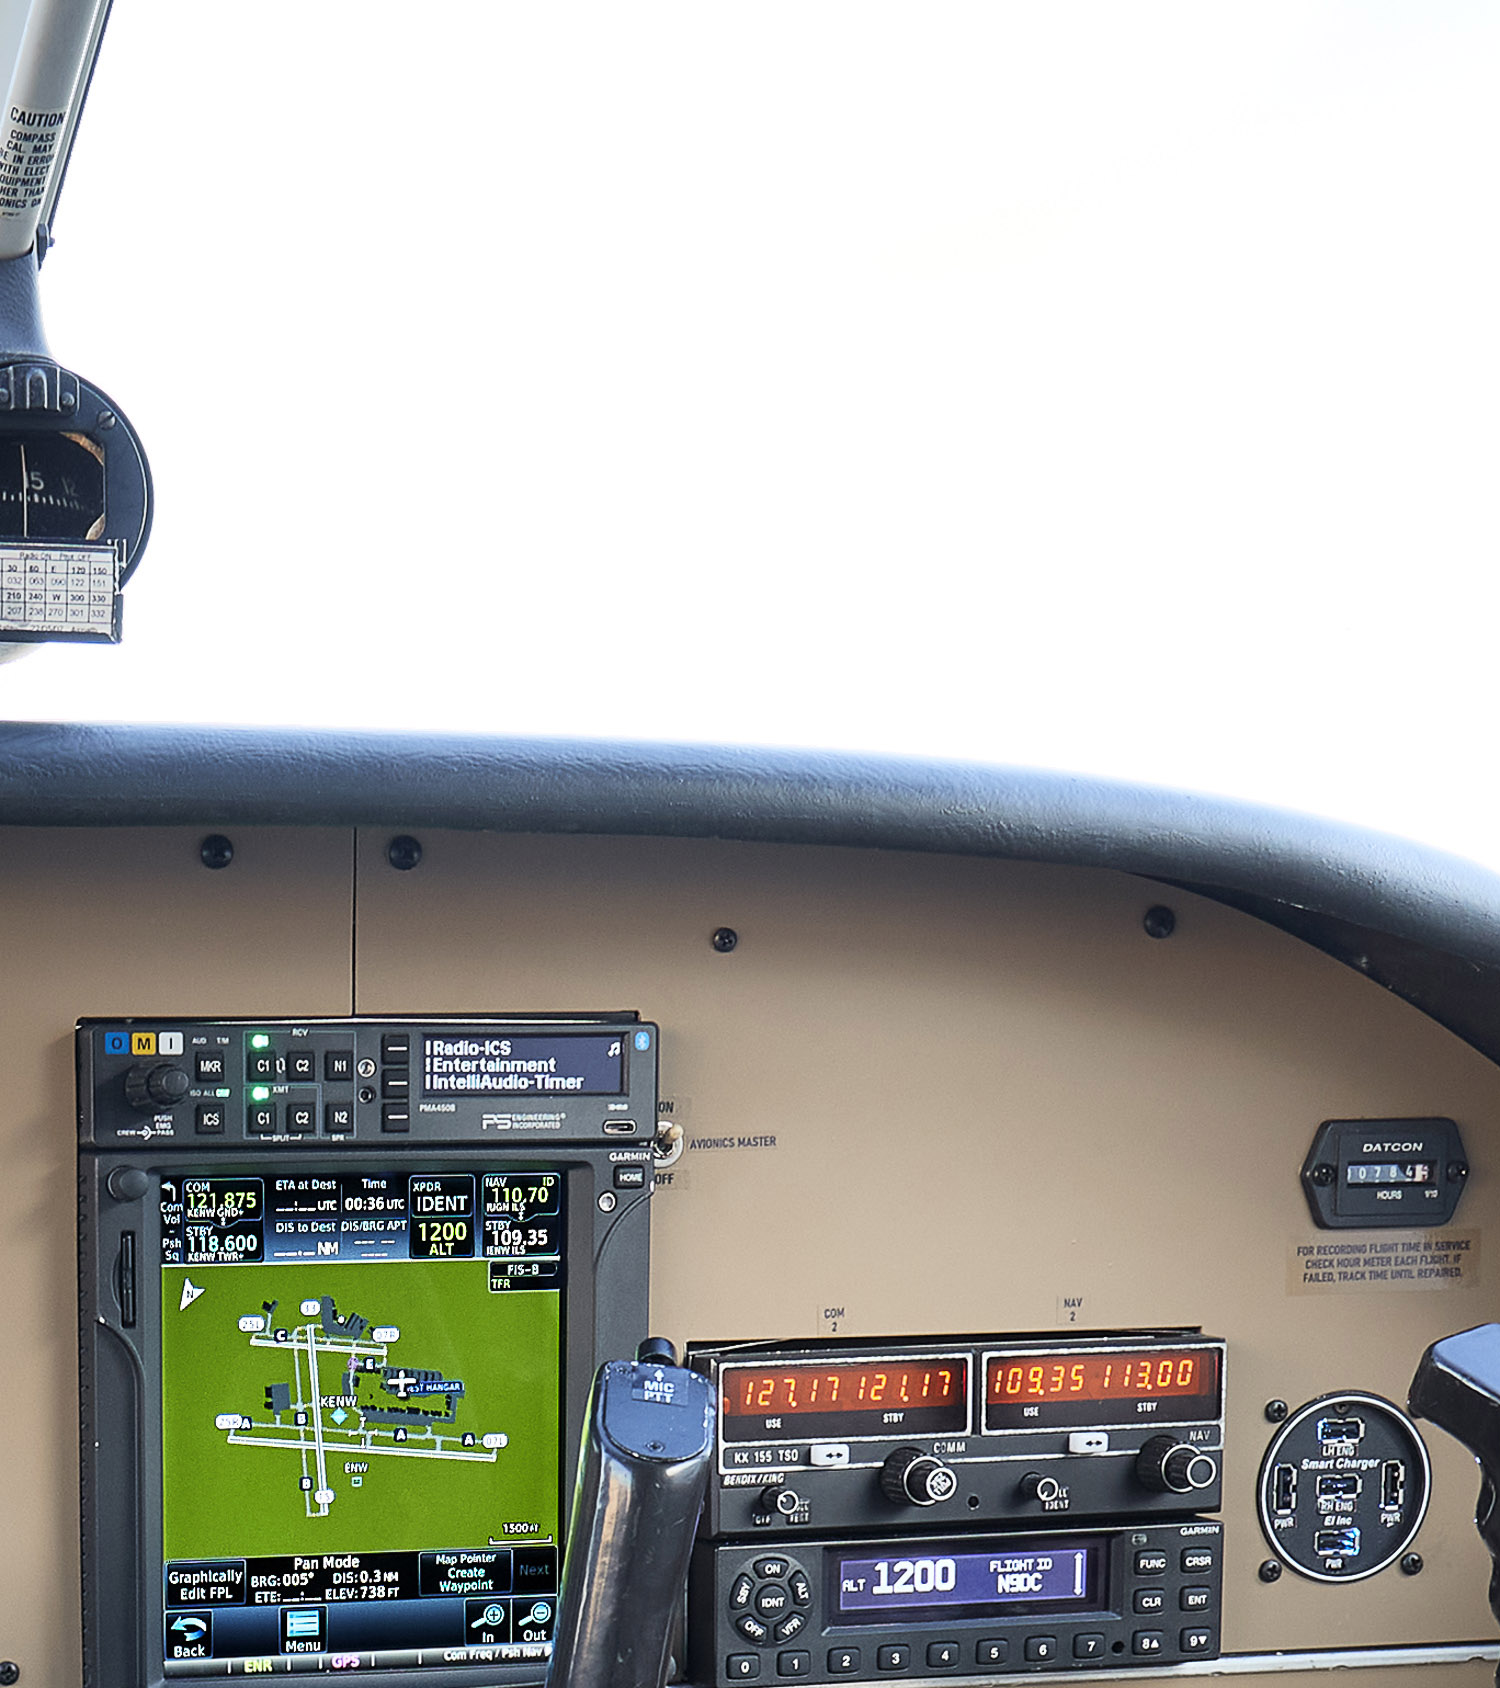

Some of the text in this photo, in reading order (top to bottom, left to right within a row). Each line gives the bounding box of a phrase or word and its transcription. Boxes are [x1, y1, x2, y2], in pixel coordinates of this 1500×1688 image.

[11, 106, 66, 128] CAUTION
[11, 130, 56, 143] COMPASS
[434, 1040, 511, 1056] Radio-ICS
[200, 1060, 221, 1073] MKR
[434, 1056, 556, 1074] Entertainment
[433, 1073, 584, 1092] IntelliAudio-Timer
[690, 1135, 777, 1150] AVIONICS MASTER
[1363, 1142, 1423, 1153] DATCON
[609, 1152, 651, 1162] GARMIN
[186, 1193, 256, 1212] 121.875
[417, 1224, 466, 1242] 1200
[492, 1229, 547, 1246] 109.35
[186, 1235, 258, 1252] 118.600
[1297, 1240, 1471, 1256] FOR RECORDING FLIGHT TIME IN SERVICE
[994, 1364, 1084, 1394] 109.35
[320, 1395, 357, 1408] KENW
[734, 1449, 798, 1464] KX 155 TSO
[1301, 1456, 1380, 1470] Smart Charger
[294, 1555, 360, 1571] Pan Mode
[168, 1571, 243, 1585] Graphically
[872, 1560, 956, 1593] 1200
[997, 1572, 1042, 1592] N9DC
[286, 1639, 320, 1653] Menu
